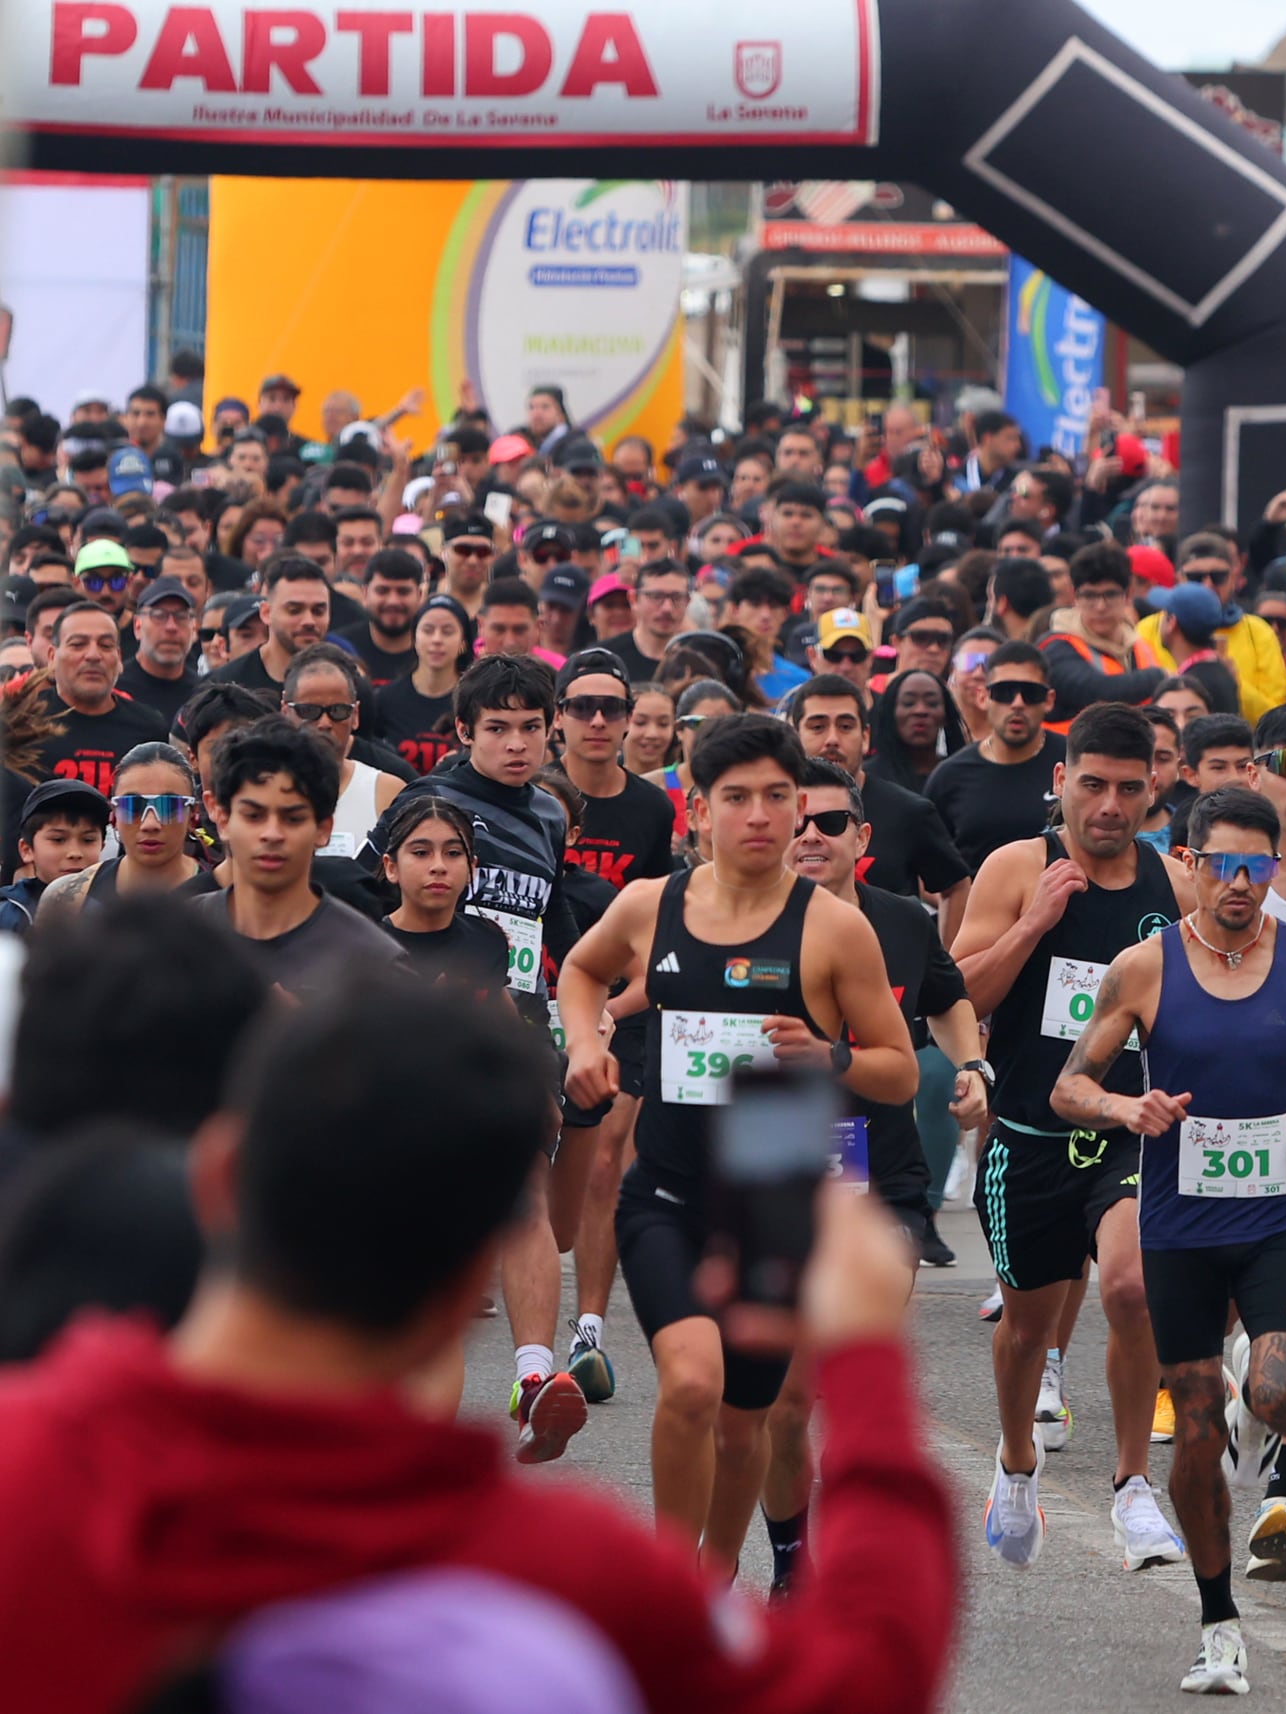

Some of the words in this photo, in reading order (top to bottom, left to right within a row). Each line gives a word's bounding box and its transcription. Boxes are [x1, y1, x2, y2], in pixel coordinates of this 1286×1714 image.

[48, 2, 662, 99] PARTIDA
[264, 106, 414, 129] Municipalidad
[456, 109, 480, 126] La
[488, 109, 558, 127] Serena
[706, 103, 731, 121] La
[738, 102, 808, 121] Serena
[525, 207, 682, 252] Electrolit
[1050, 292, 1099, 460] Electr
[722, 1017, 737, 1027] 5K
[1238, 1122, 1253, 1131] 5K
[1202, 1149, 1270, 1178] 301
[1264, 1185, 1280, 1194] 301
